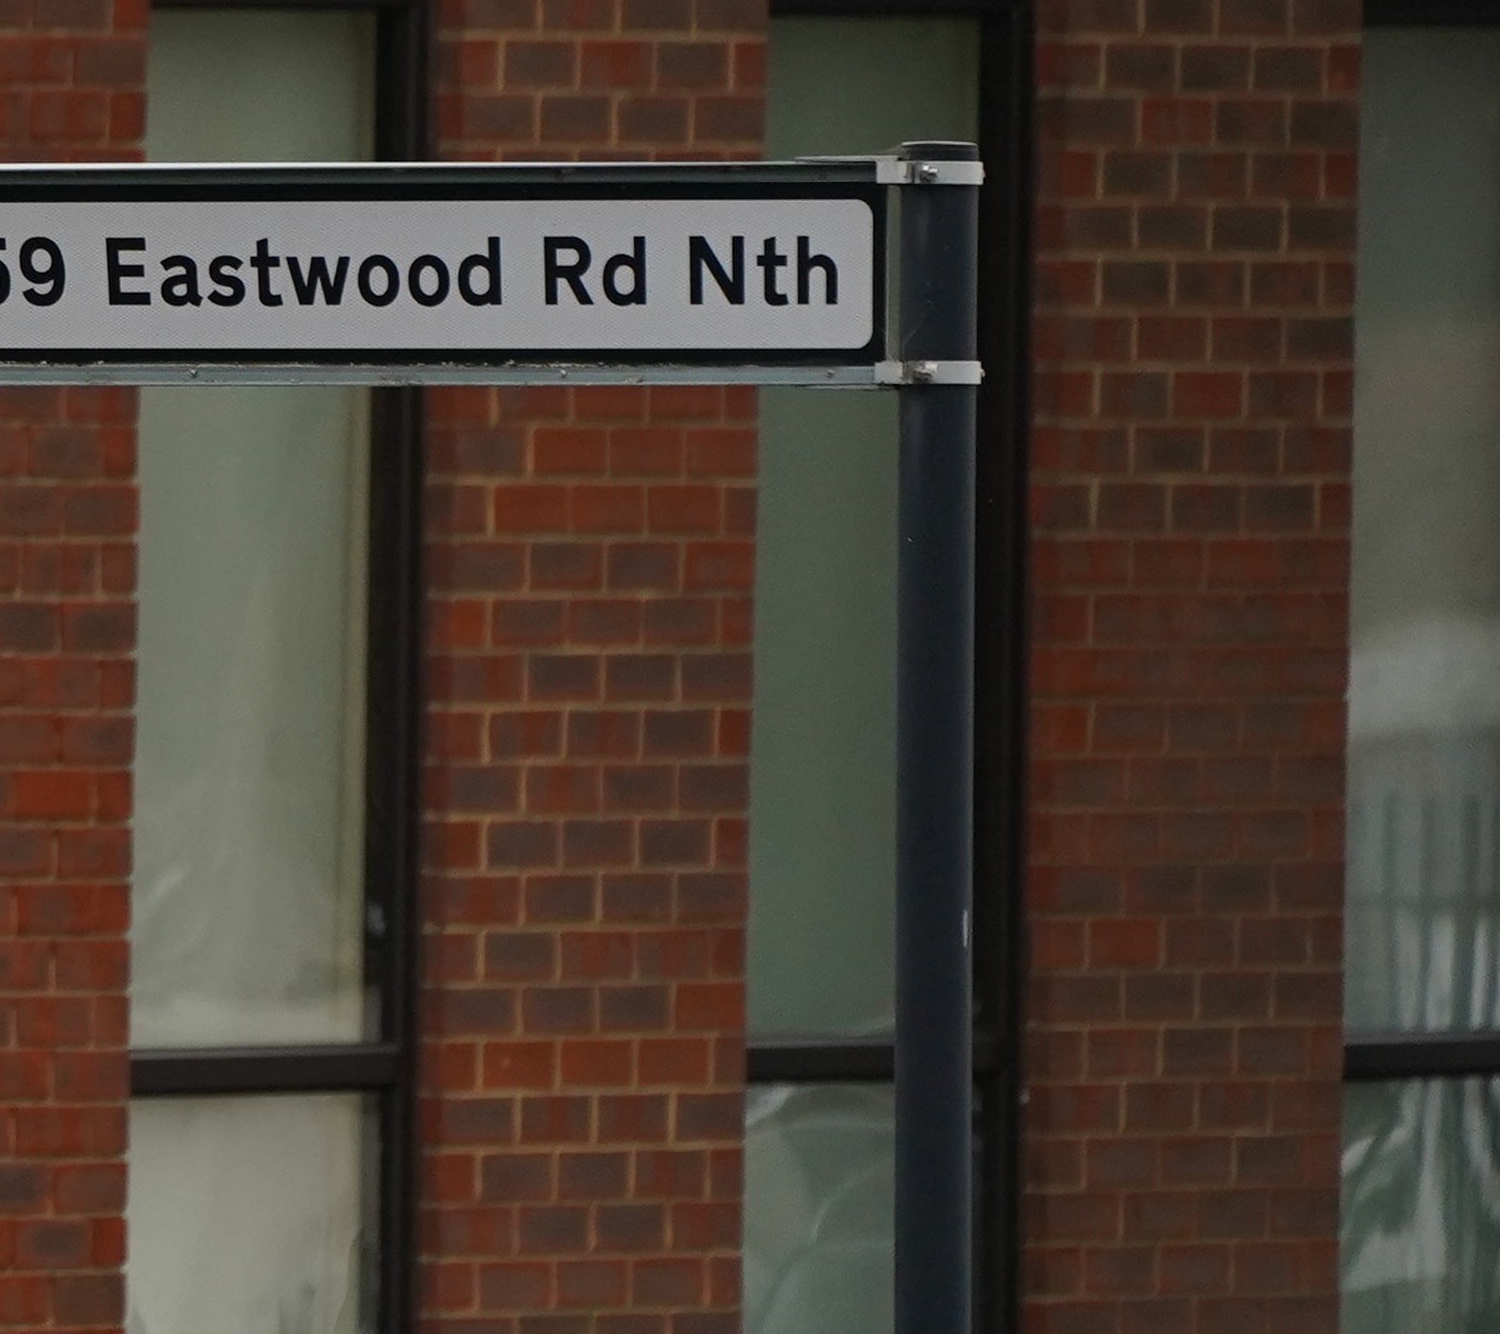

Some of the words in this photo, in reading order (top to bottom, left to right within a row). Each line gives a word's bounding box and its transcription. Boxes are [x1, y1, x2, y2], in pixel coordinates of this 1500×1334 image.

[106, 237, 502, 307] Eastwood
[544, 236, 646, 306] Rd
[689, 236, 837, 306] Nth
